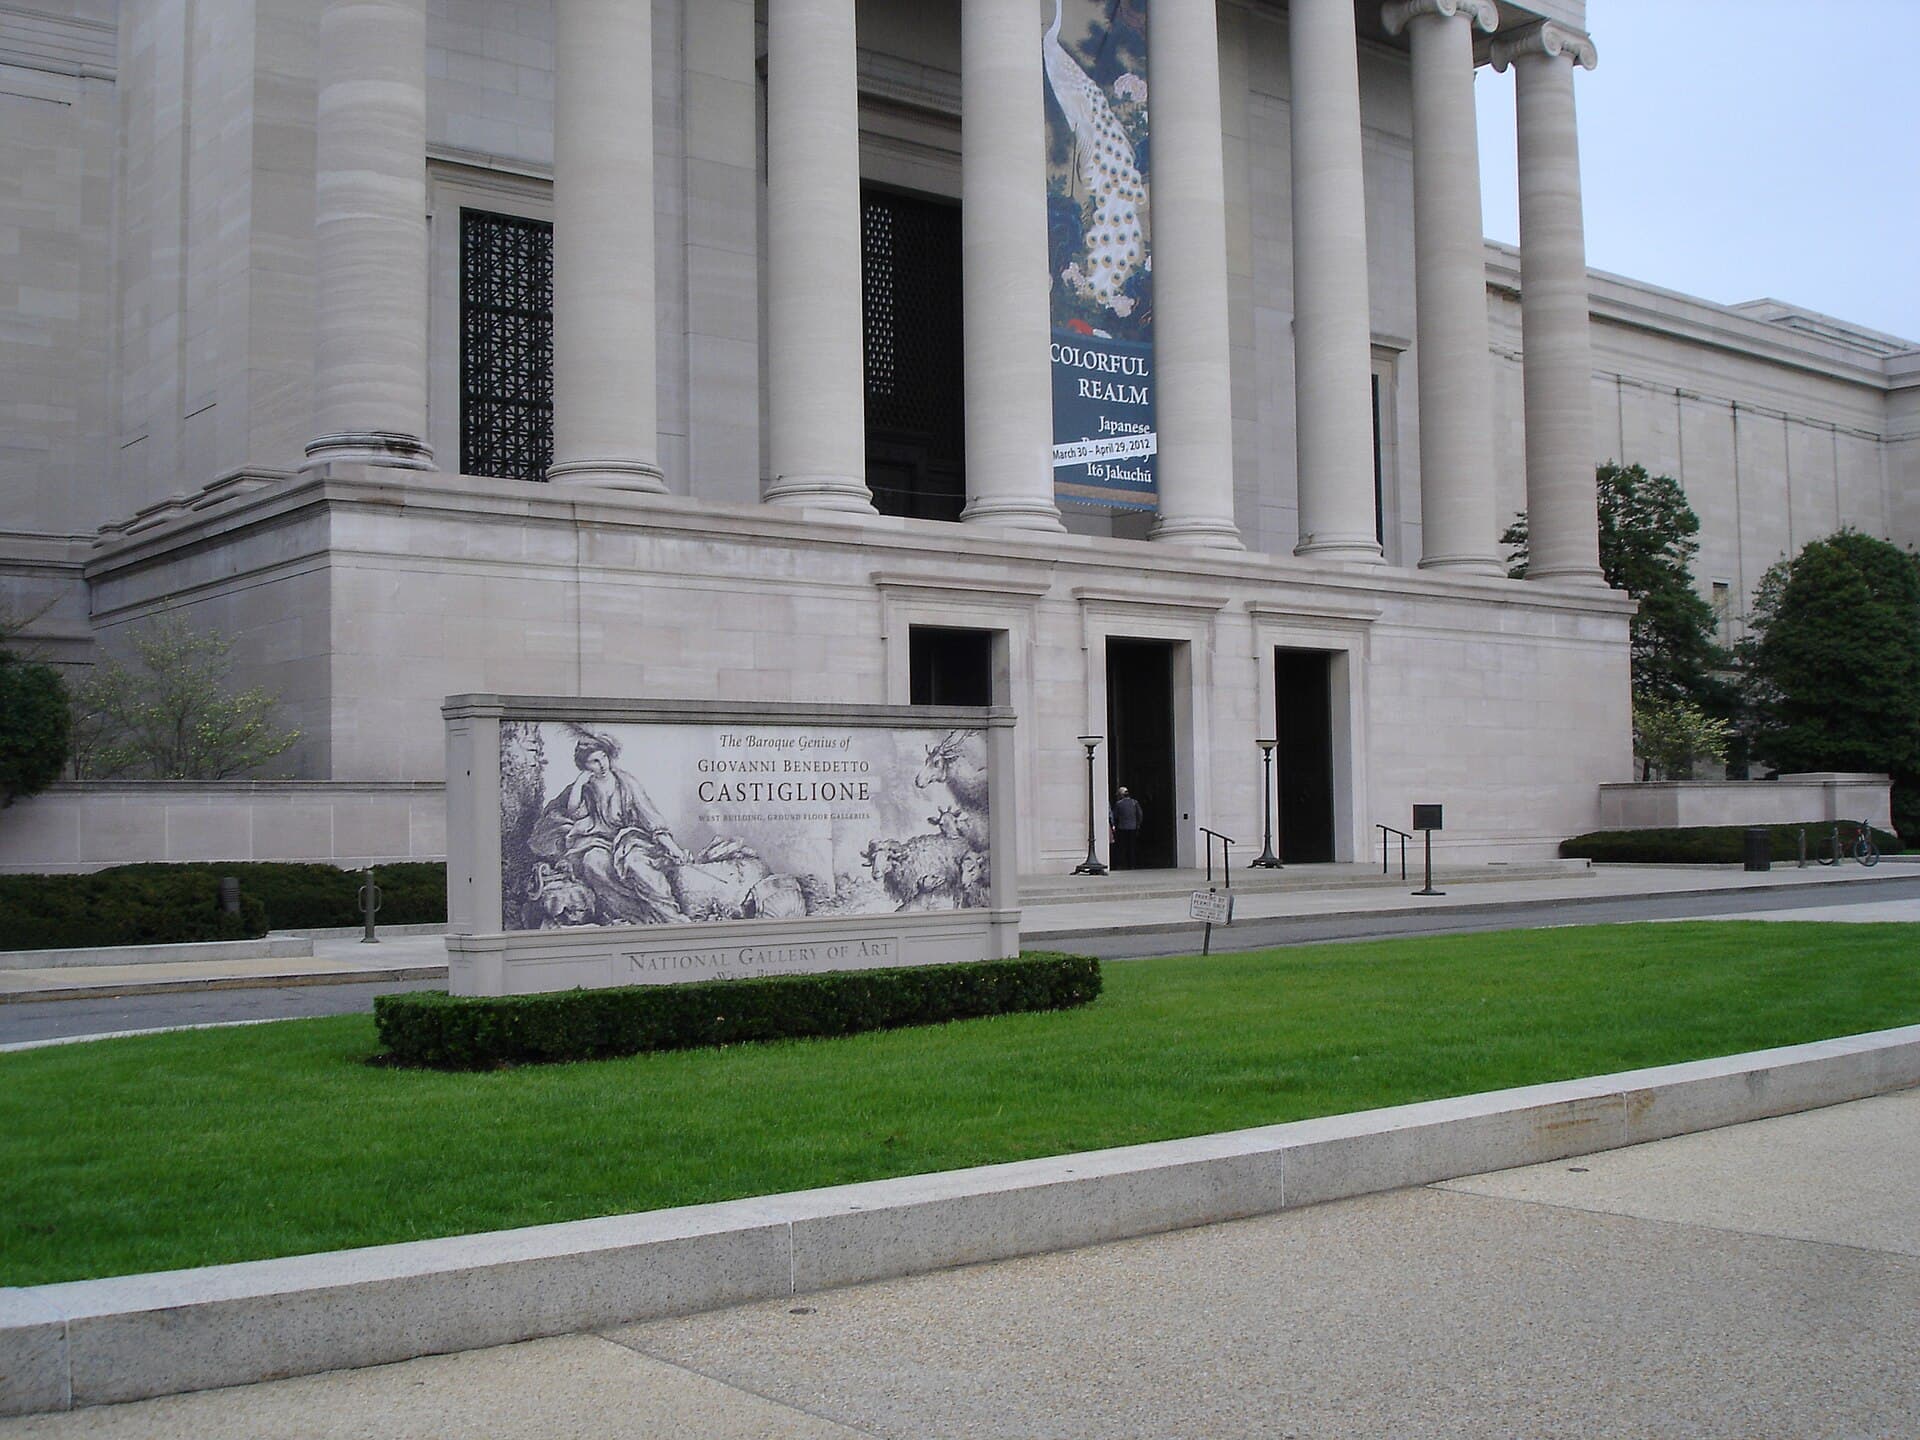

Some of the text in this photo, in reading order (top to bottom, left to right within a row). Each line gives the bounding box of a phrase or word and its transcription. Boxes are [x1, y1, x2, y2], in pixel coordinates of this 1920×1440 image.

[1050, 343, 1149, 377] COLORFUL
[1078, 378, 1149, 405] REALM
[1098, 416, 1150, 435] Japanese
[1053, 448, 1076, 460] March
[1078, 446, 1087, 457] 30
[1095, 443, 1113, 456] April
[1115, 442, 1128, 453] 29,
[1129, 439, 1150, 450] 2012
[720, 735, 852, 752] The Baroque Genius of
[697, 759, 869, 773] GIOVANNI BENEDETTO
[698, 781, 870, 802] CASTIGLIONE
[699, 814, 720, 822] WEST
[767, 814, 800, 822] GROUND
[803, 813, 827, 821] FLOOR
[830, 812, 871, 821] GALLERIES
[629, 941, 890, 973] NATIONAL GALLERY OF ART
